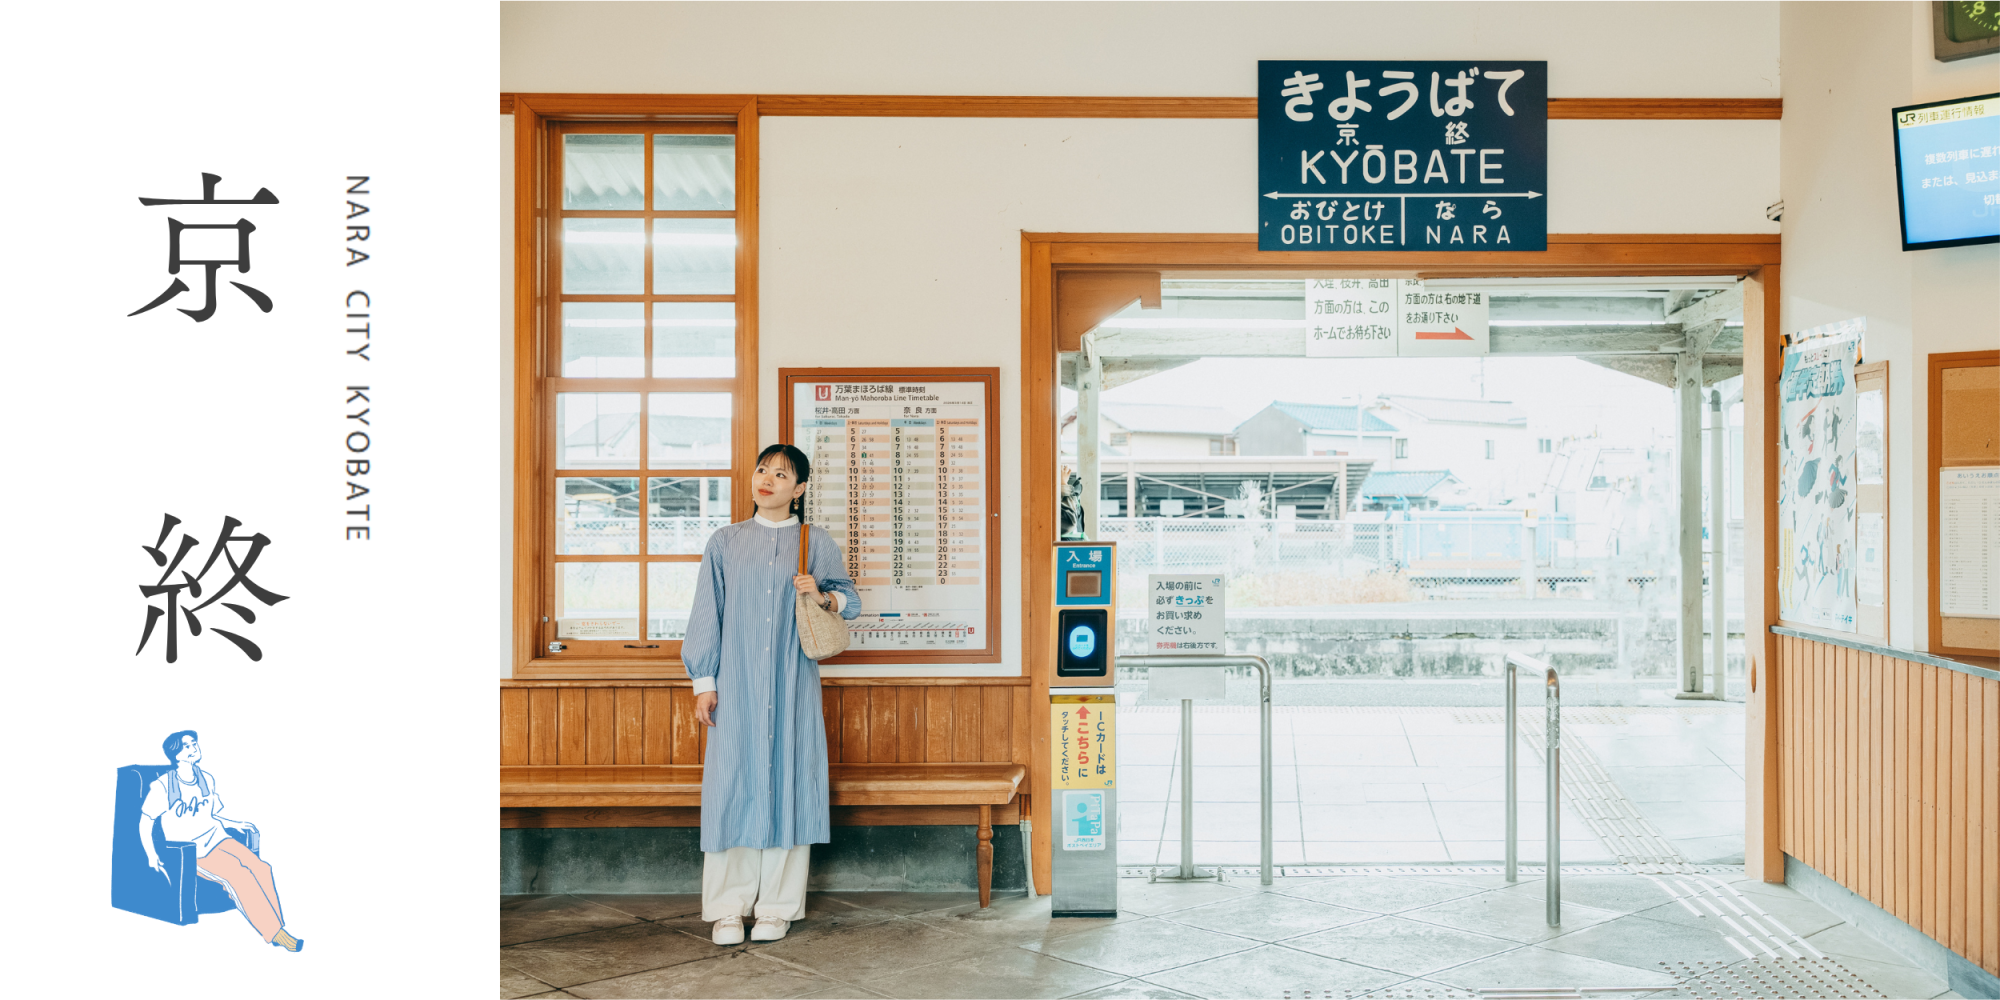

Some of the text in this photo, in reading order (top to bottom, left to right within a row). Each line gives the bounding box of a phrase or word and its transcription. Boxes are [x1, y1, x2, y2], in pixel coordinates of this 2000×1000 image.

[1973, 1, 1986, 15] 8
[1281, 66, 1525, 122] きようばて
[1900, 104, 1984, 124] JR 列車運行情報
[1301, 144, 1504, 184] KYŌBATE
[1922, 170, 2000, 188] または、見込ま
[1290, 200, 1384, 221] おびとけ
[1435, 200, 1502, 221] なら
[1280, 224, 1394, 244] OBITOKE
[1426, 224, 1511, 244] NARA
[1406, 312, 1459, 324] をお通り下さい
[1314, 324, 1391, 340] ホームでお待ち下さい
[835, 385, 894, 394] 万葉まほろば線
[1066, 550, 1102, 562] 入場
[1156, 581, 1202, 591] 入場の前に
[1156, 596, 1213, 605] 必ずきっぷを
[1156, 611, 1202, 620] お買い求め
[1157, 626, 1196, 635] ください。
[1061, 712, 1069, 786] タッチしてください。
[1077, 722, 1089, 778] こちらに
[1090, 796, 1100, 834] PiTaPa
